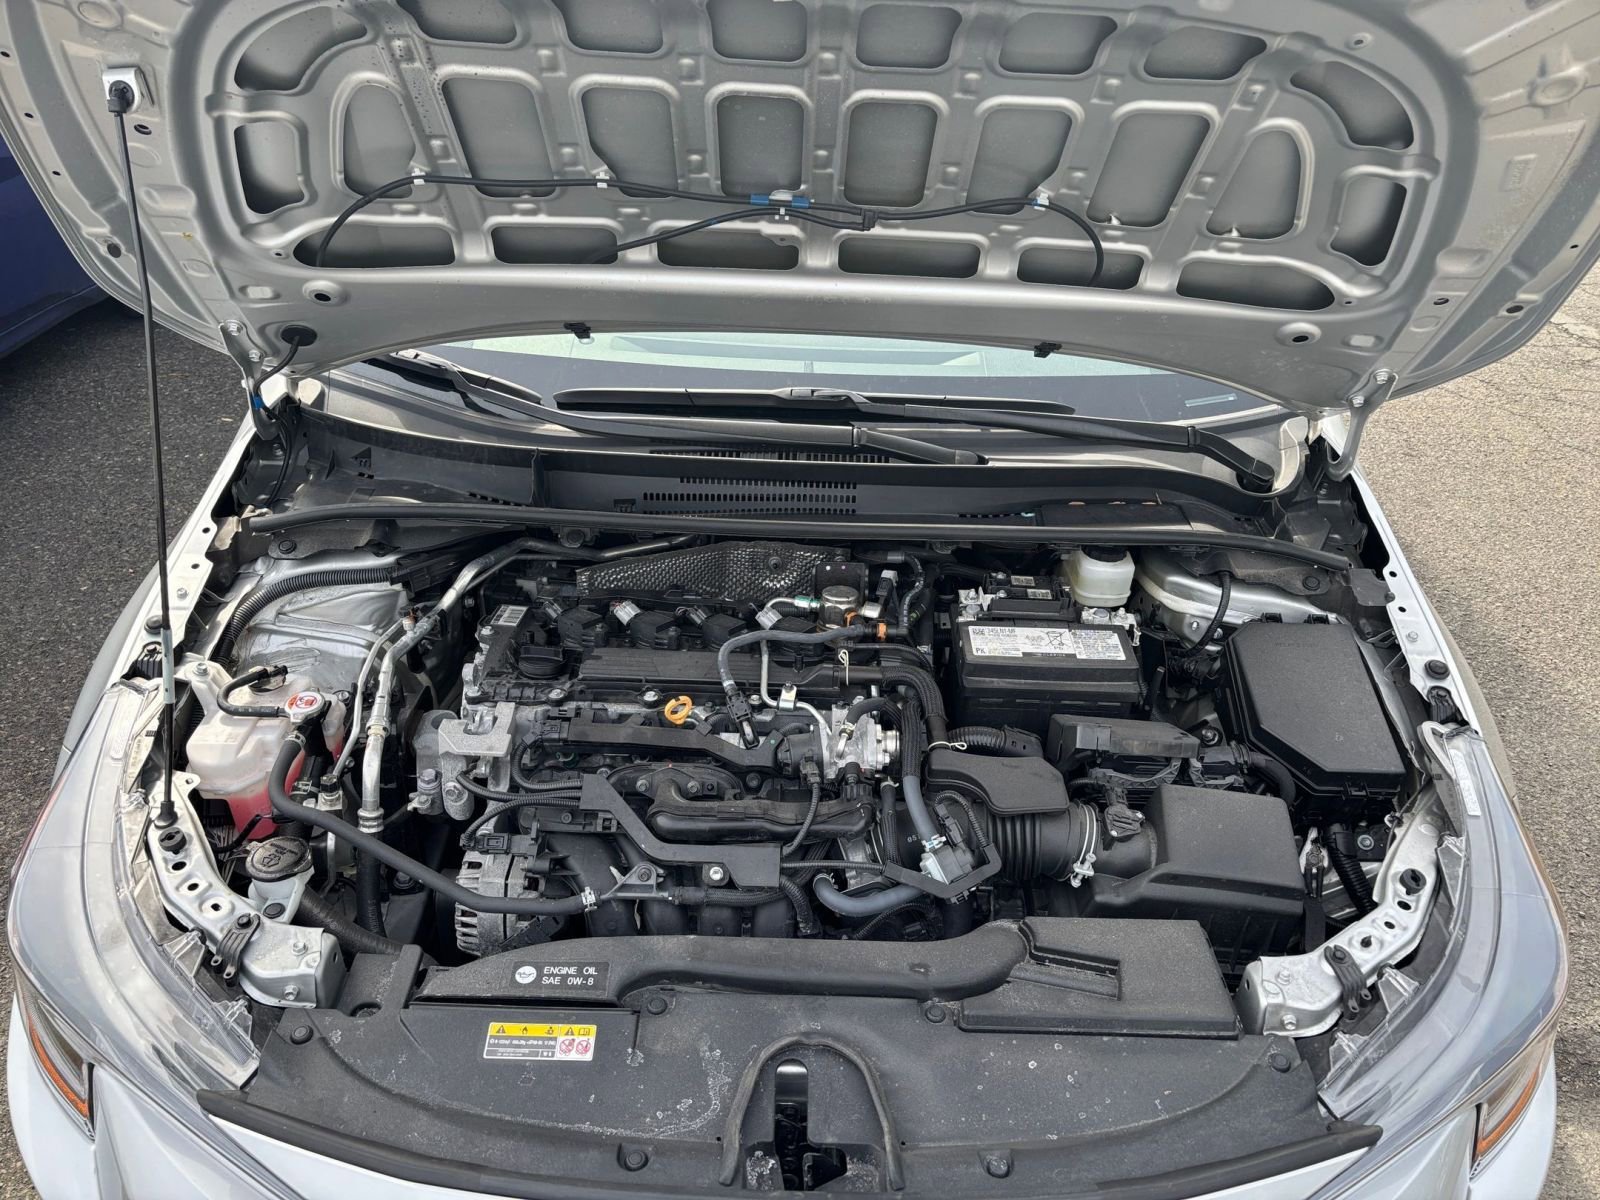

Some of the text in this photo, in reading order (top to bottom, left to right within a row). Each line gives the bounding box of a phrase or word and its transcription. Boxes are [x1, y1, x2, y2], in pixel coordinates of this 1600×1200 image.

[544, 966, 598, 975] ENGINE OIL
[542, 976, 594, 985] SAE 0W-8
